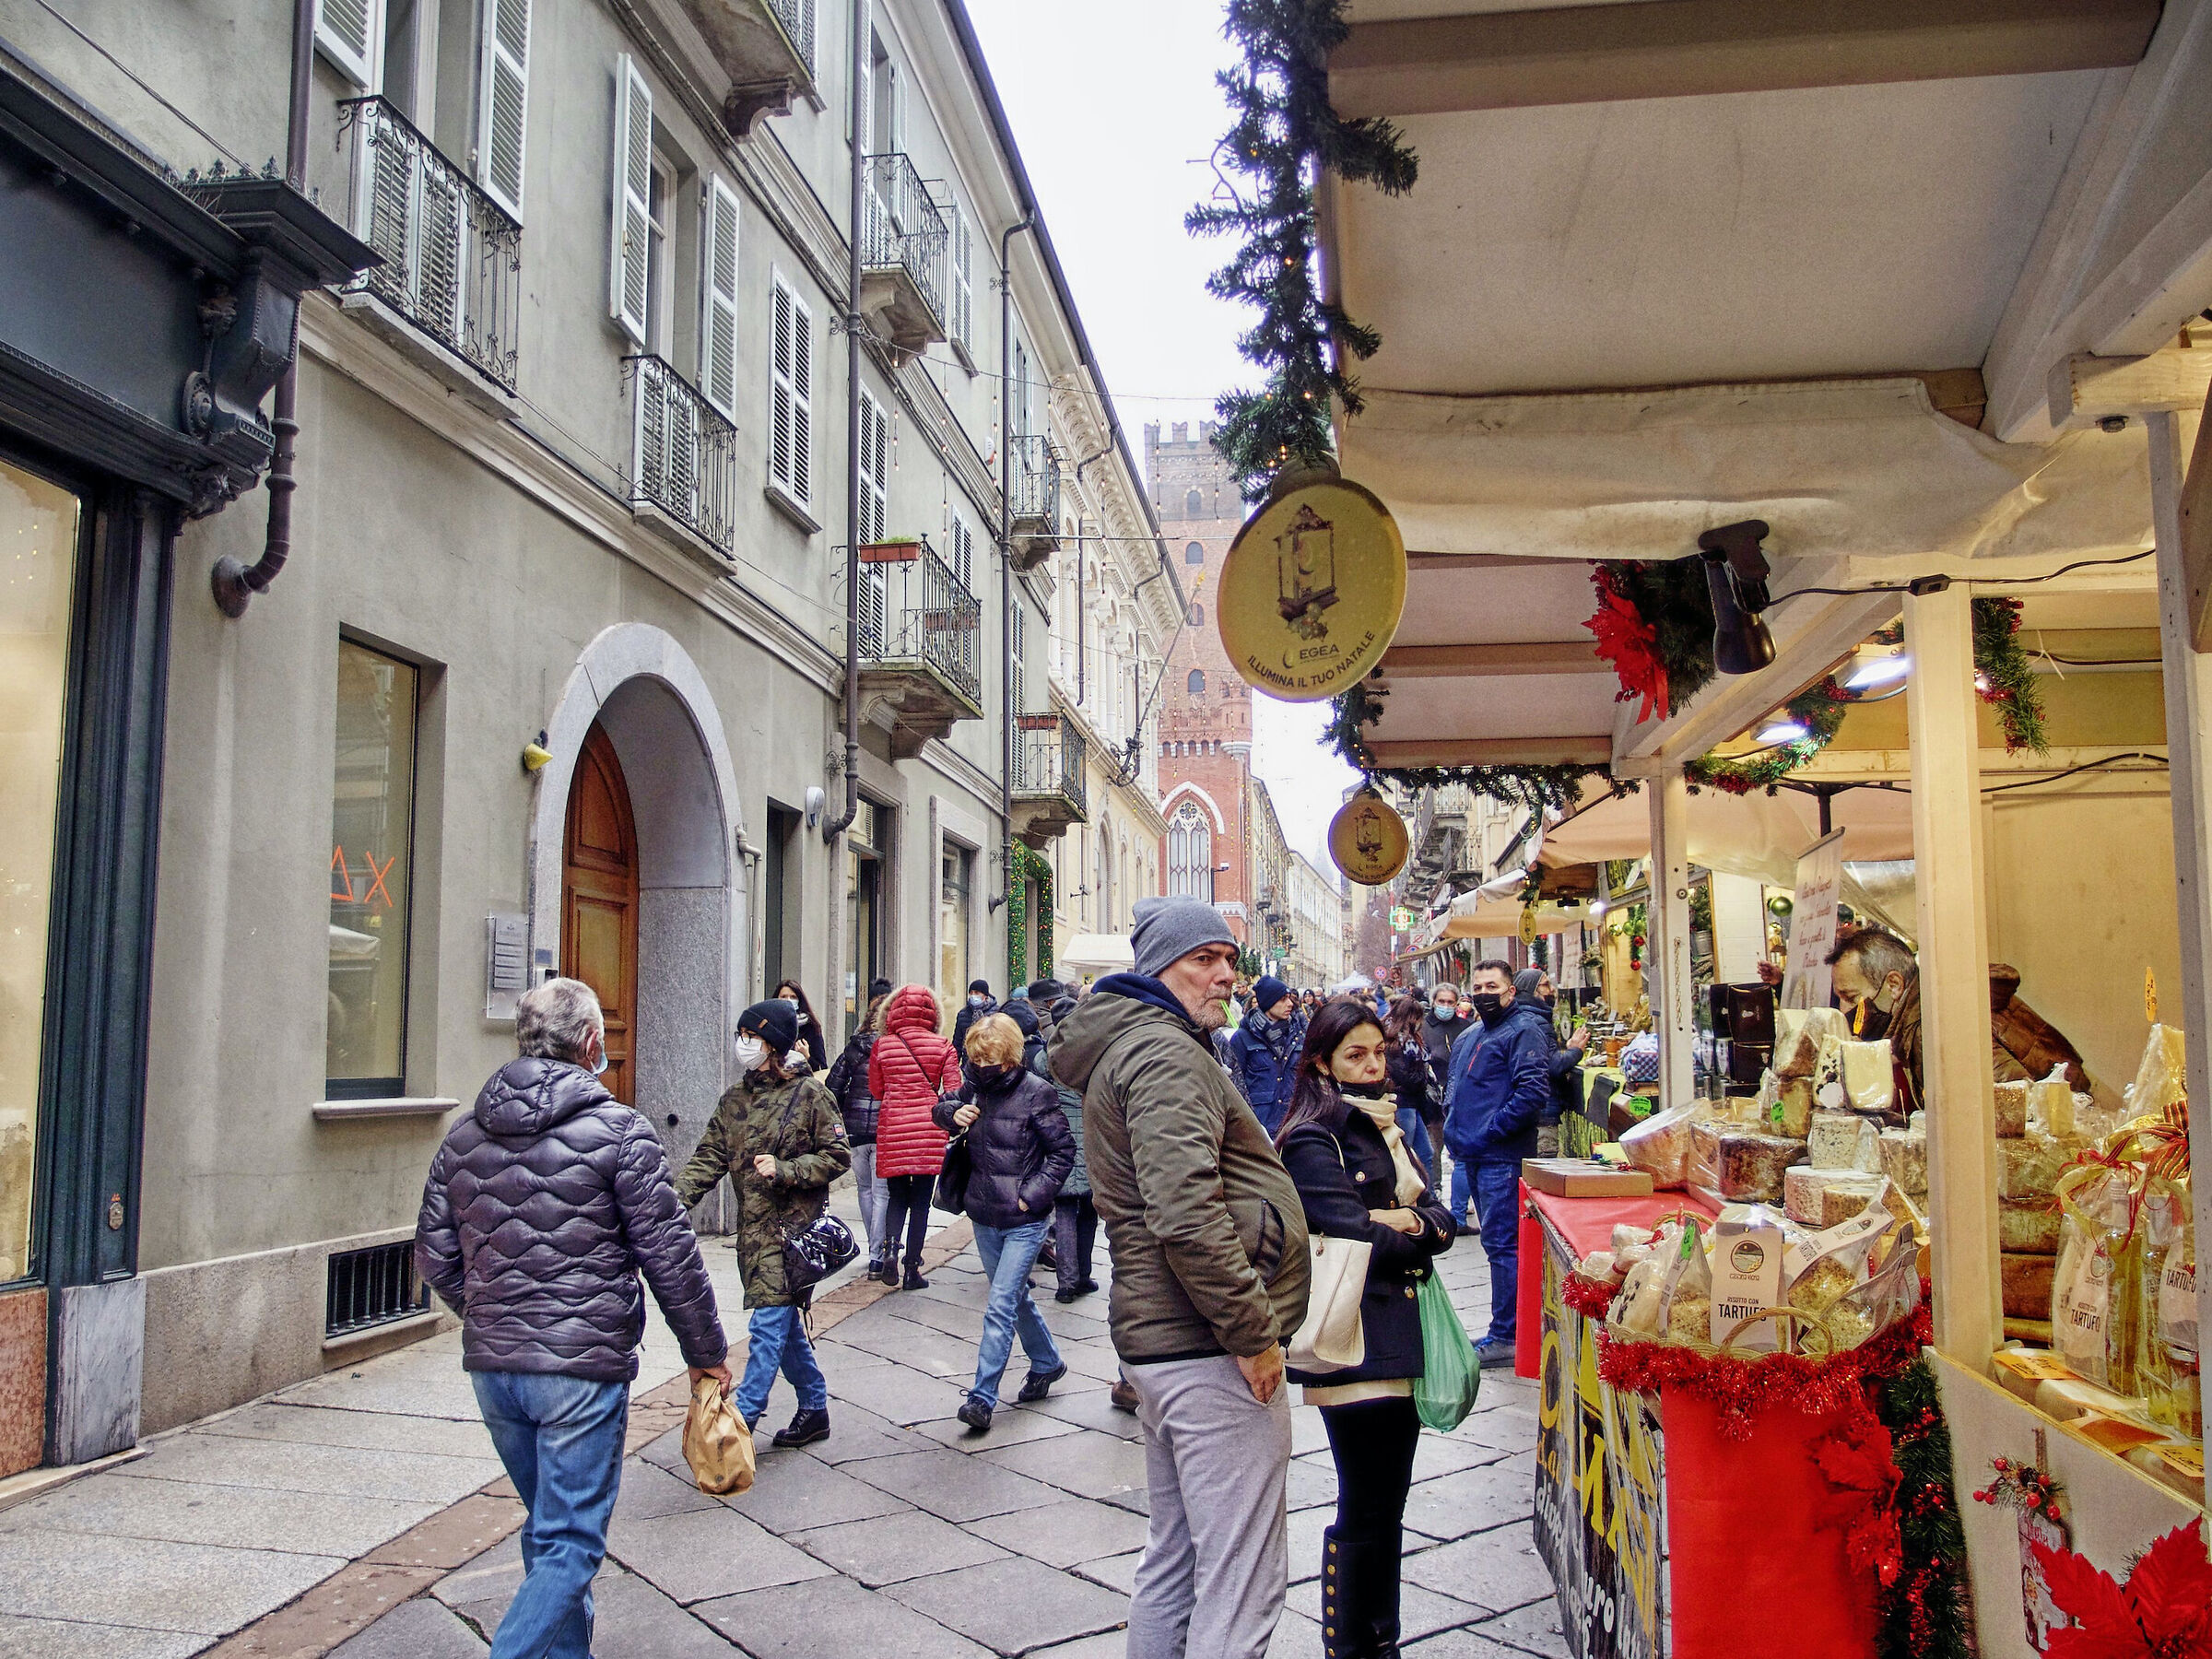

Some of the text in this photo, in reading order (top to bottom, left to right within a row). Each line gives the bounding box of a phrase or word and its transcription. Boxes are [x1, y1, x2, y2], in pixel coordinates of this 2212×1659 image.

[1247, 630, 1376, 688] ILLUMINA IL TUO NATALE
[1299, 644, 1340, 660] EGEA
[2070, 1308, 2101, 1333] TARTUFO
